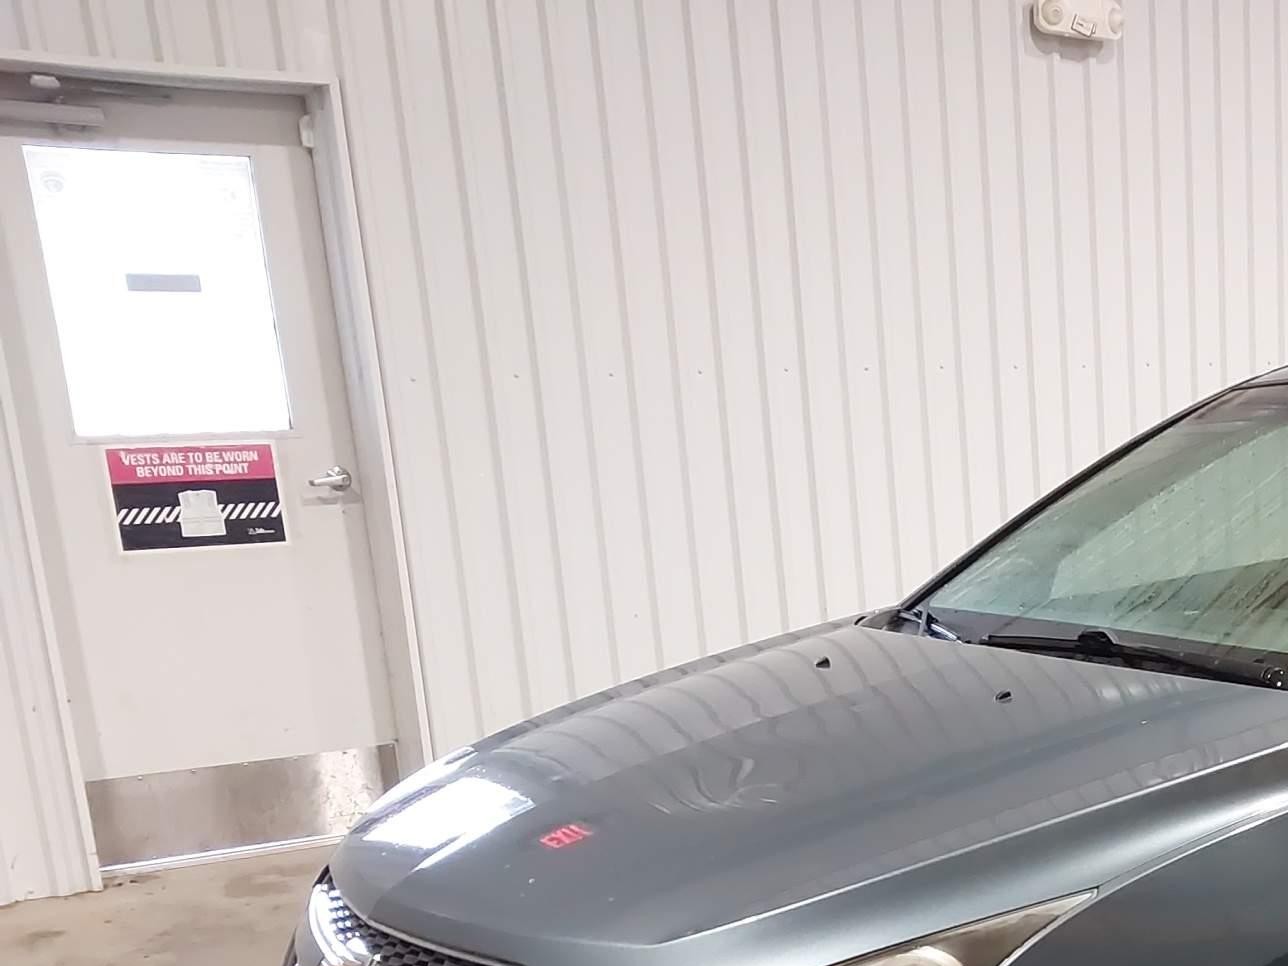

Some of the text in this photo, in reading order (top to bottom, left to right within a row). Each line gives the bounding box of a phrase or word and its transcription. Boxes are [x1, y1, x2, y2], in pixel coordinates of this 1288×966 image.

[120, 450, 258, 466] VESTS ARE TO BE WORN
[136, 463, 249, 477] BEYOND THIS POINT
